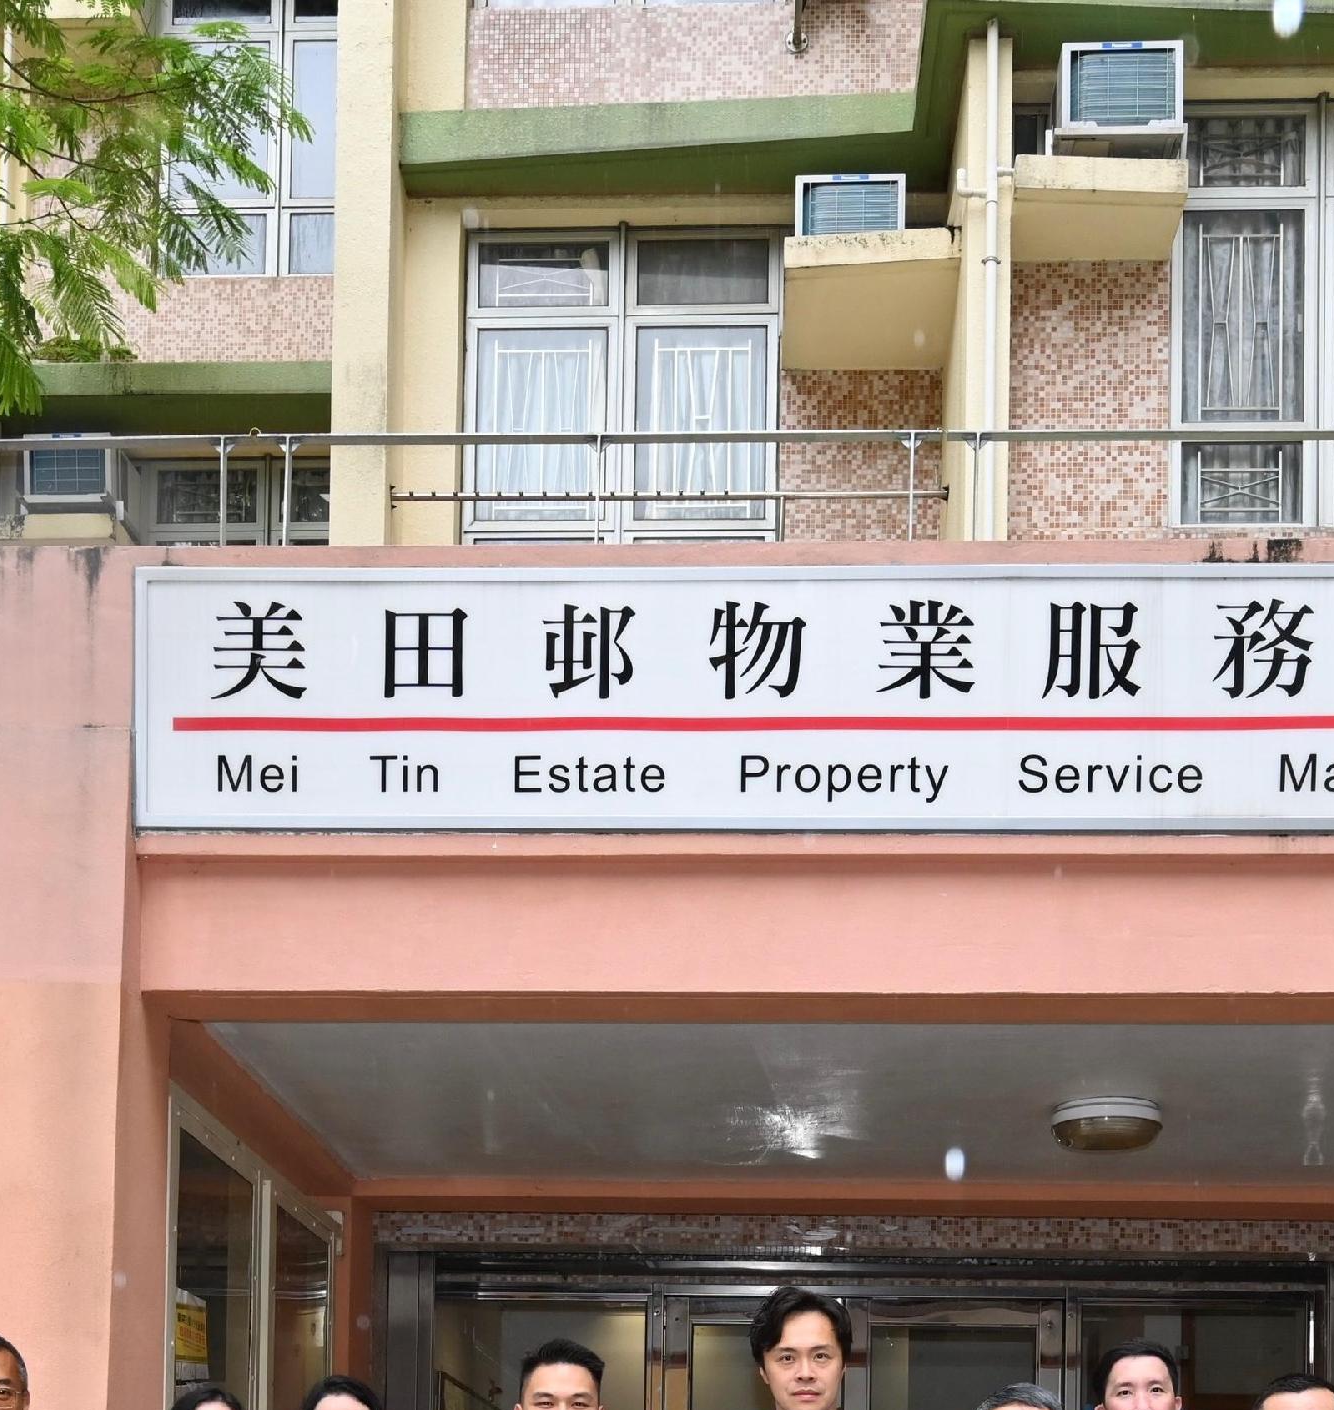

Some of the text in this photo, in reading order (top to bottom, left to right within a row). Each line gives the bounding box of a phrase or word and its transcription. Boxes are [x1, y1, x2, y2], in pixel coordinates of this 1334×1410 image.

[218, 754, 300, 796] Mei
[370, 754, 440, 796] Tin
[514, 754, 666, 796] Estate
[741, 754, 949, 807] Property
[1018, 754, 1204, 796] Service
